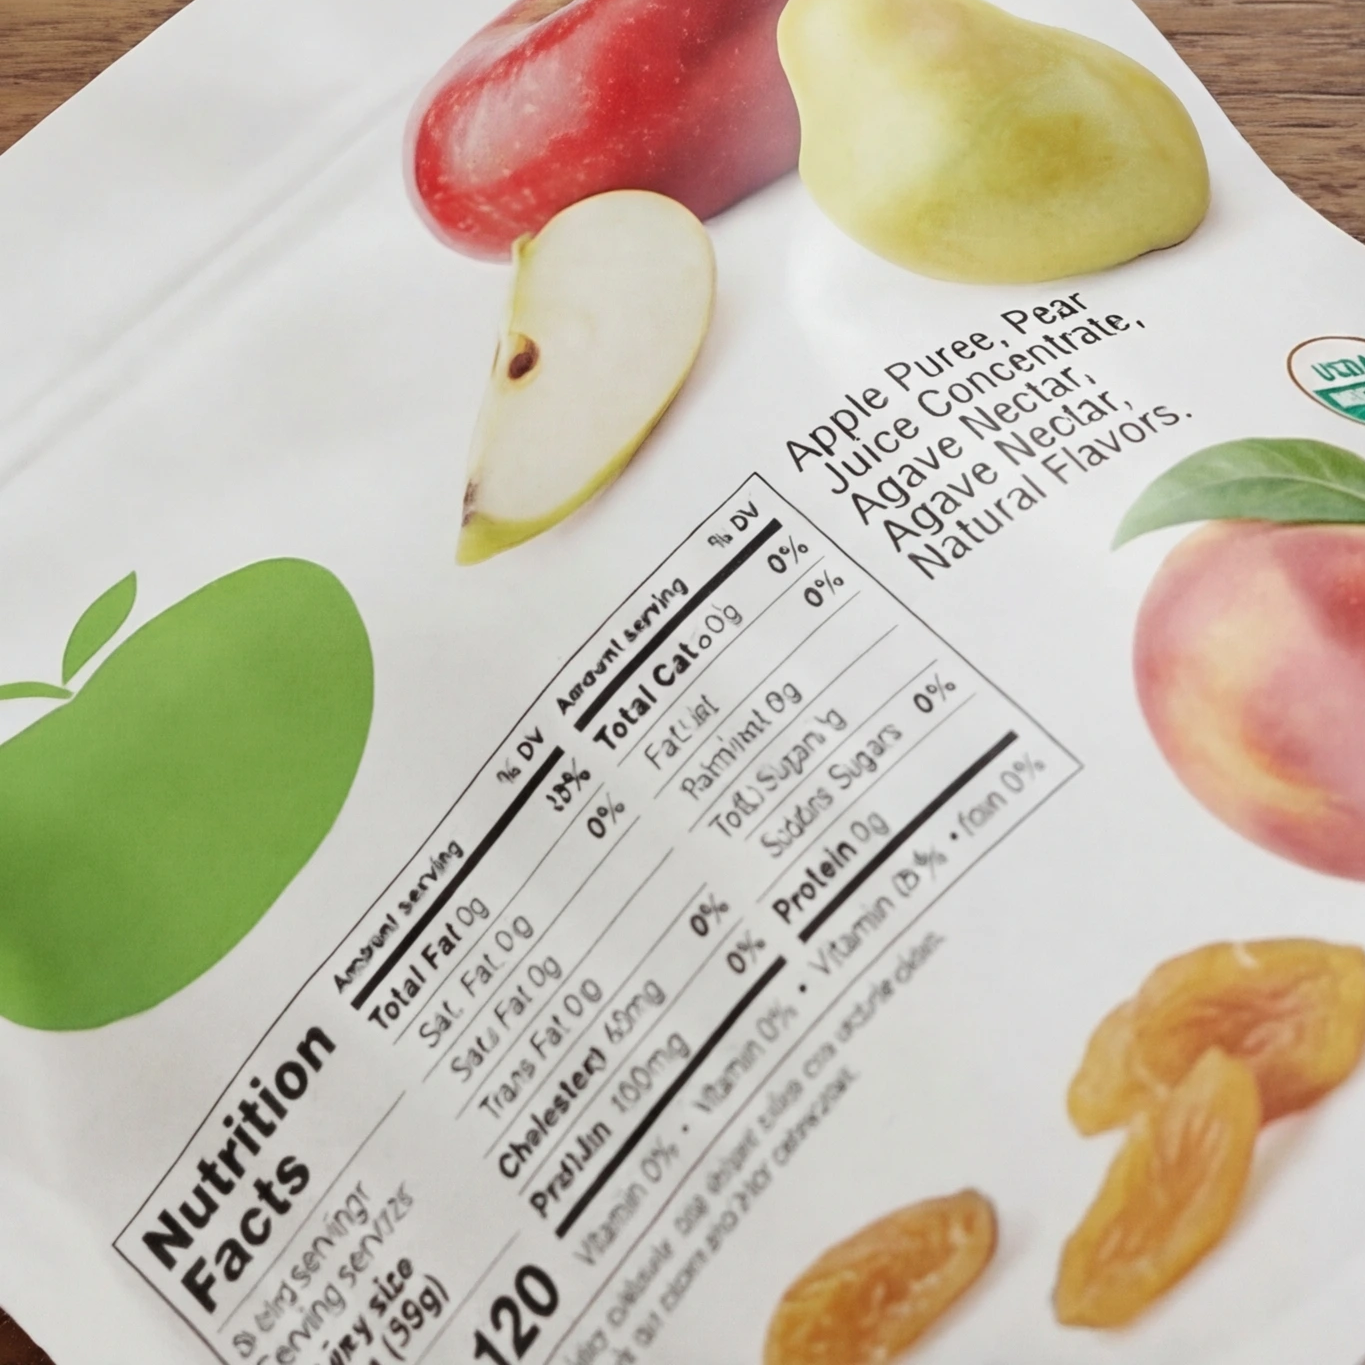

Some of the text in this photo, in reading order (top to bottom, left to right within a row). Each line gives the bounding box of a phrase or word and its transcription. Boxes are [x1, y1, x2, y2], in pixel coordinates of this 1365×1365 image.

[785, 291, 1088, 474] Apple Puree, Pear
[823, 313, 1146, 495] Juice Concentrate,
[850, 365, 1097, 527] Agave Nectar,
[906, 405, 1193, 581] Natural Flavors.
[591, 682, 659, 751] Total
[770, 840, 859, 926] Protein
[366, 921, 464, 1031] Total Fat
[140, 1025, 338, 1273] Nutrition
[179, 1154, 312, 1316] Facts
